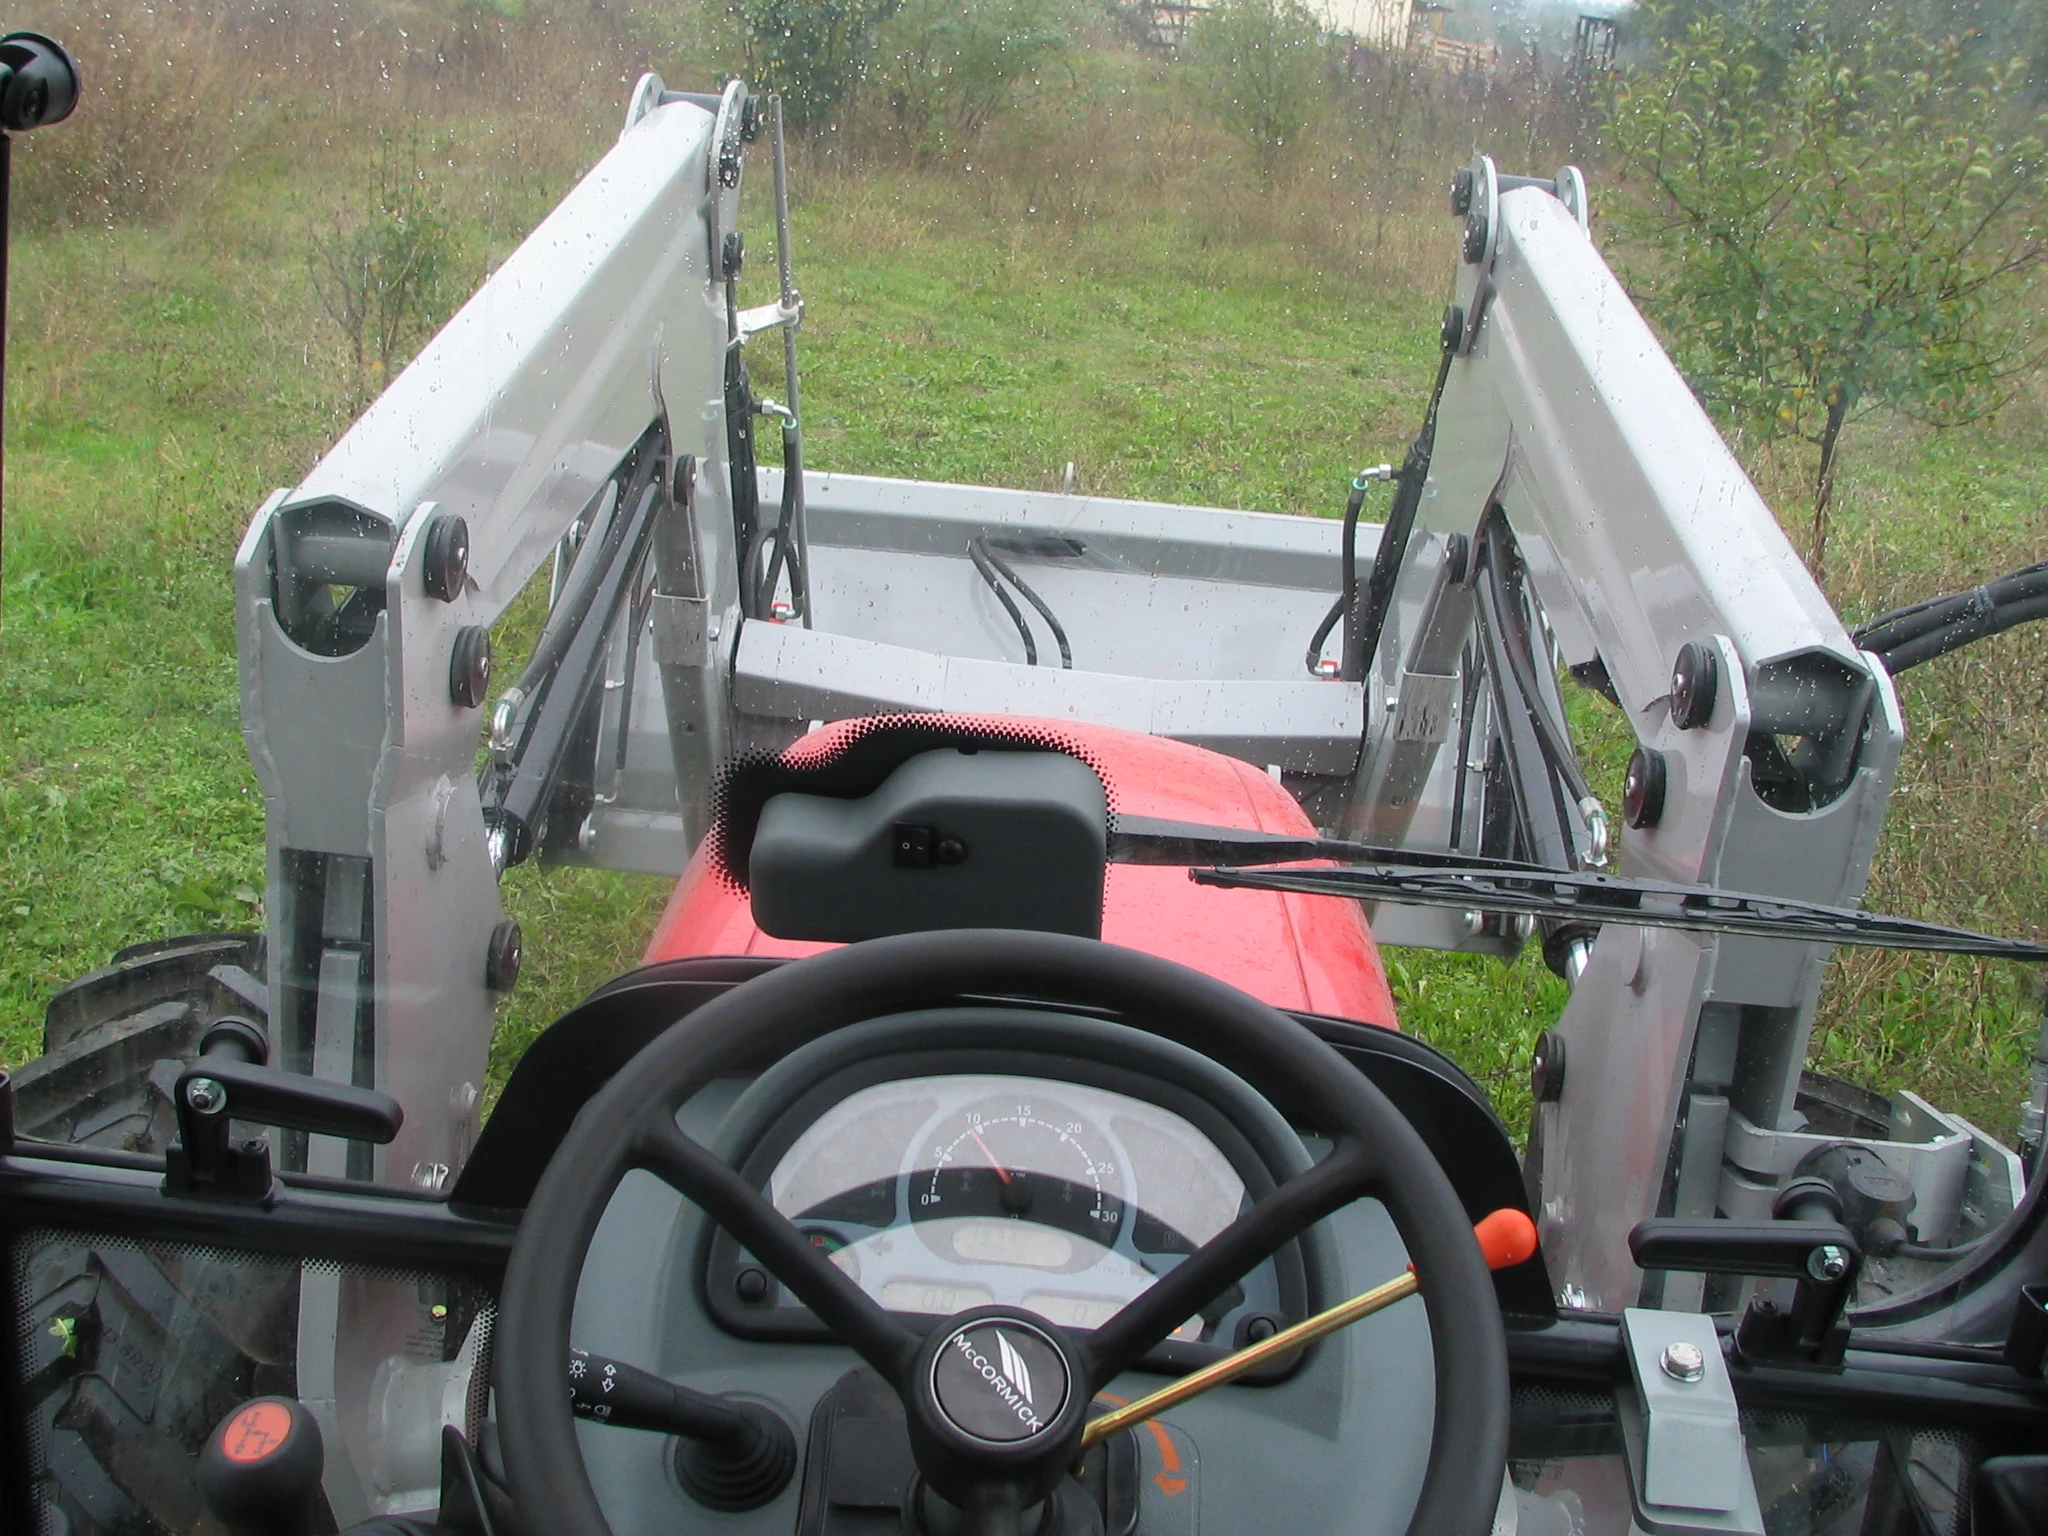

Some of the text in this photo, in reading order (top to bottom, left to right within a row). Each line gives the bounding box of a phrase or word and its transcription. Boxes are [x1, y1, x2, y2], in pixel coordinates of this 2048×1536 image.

[1016, 1105, 1031, 1116] 15
[965, 1113, 981, 1124] 10
[1066, 1122, 1082, 1134] 20
[935, 1146, 943, 1157] 5
[1098, 1162, 1114, 1174] 25
[921, 1194, 929, 1205] 0
[1102, 1211, 1118, 1223] 30
